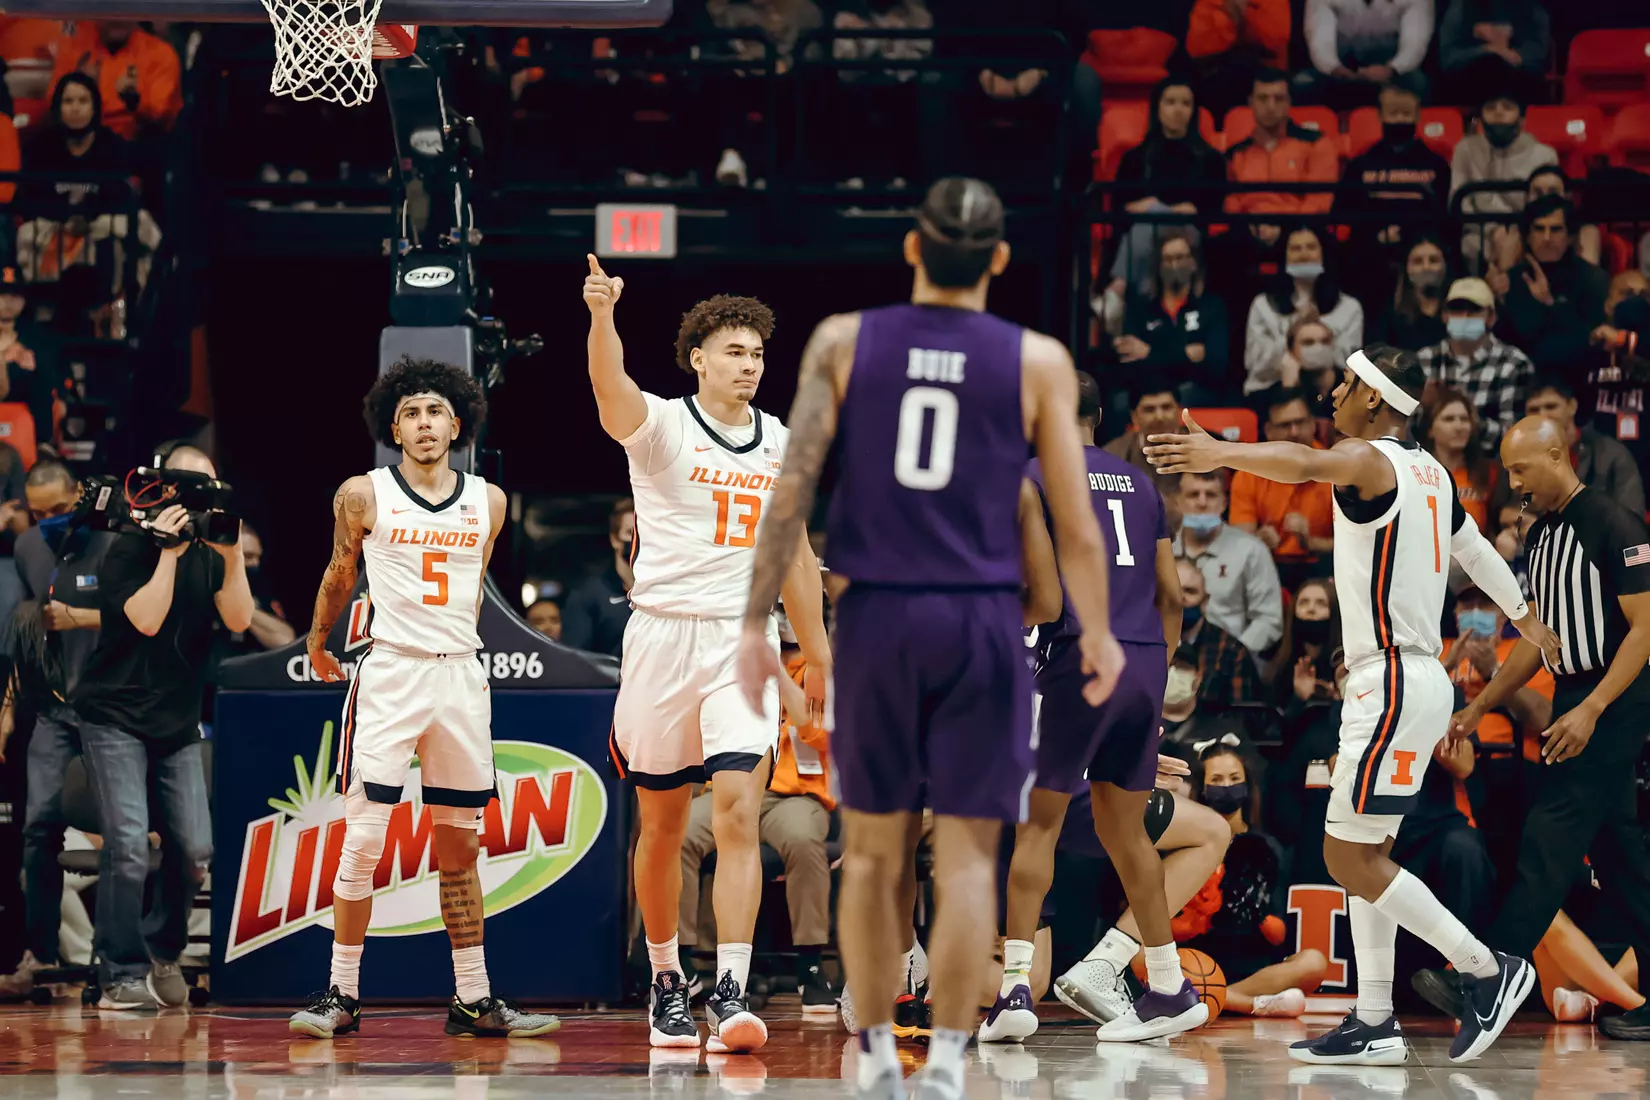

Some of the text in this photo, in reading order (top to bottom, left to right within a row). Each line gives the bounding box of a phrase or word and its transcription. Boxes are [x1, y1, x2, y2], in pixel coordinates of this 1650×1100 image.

[611, 209, 664, 253] EXIT
[894, 386, 960, 491] 0
[1087, 472, 1135, 493] AUDIGE
[389, 528, 480, 548] ILLINOIS
[713, 491, 762, 548] 13
[1106, 498, 1135, 567] 1
[1426, 495, 1441, 574] 1
[422, 551, 449, 606] 5
[480, 652, 544, 679] 1896
[1390, 750, 1417, 786] I
[234, 769, 574, 947] LIMAN
